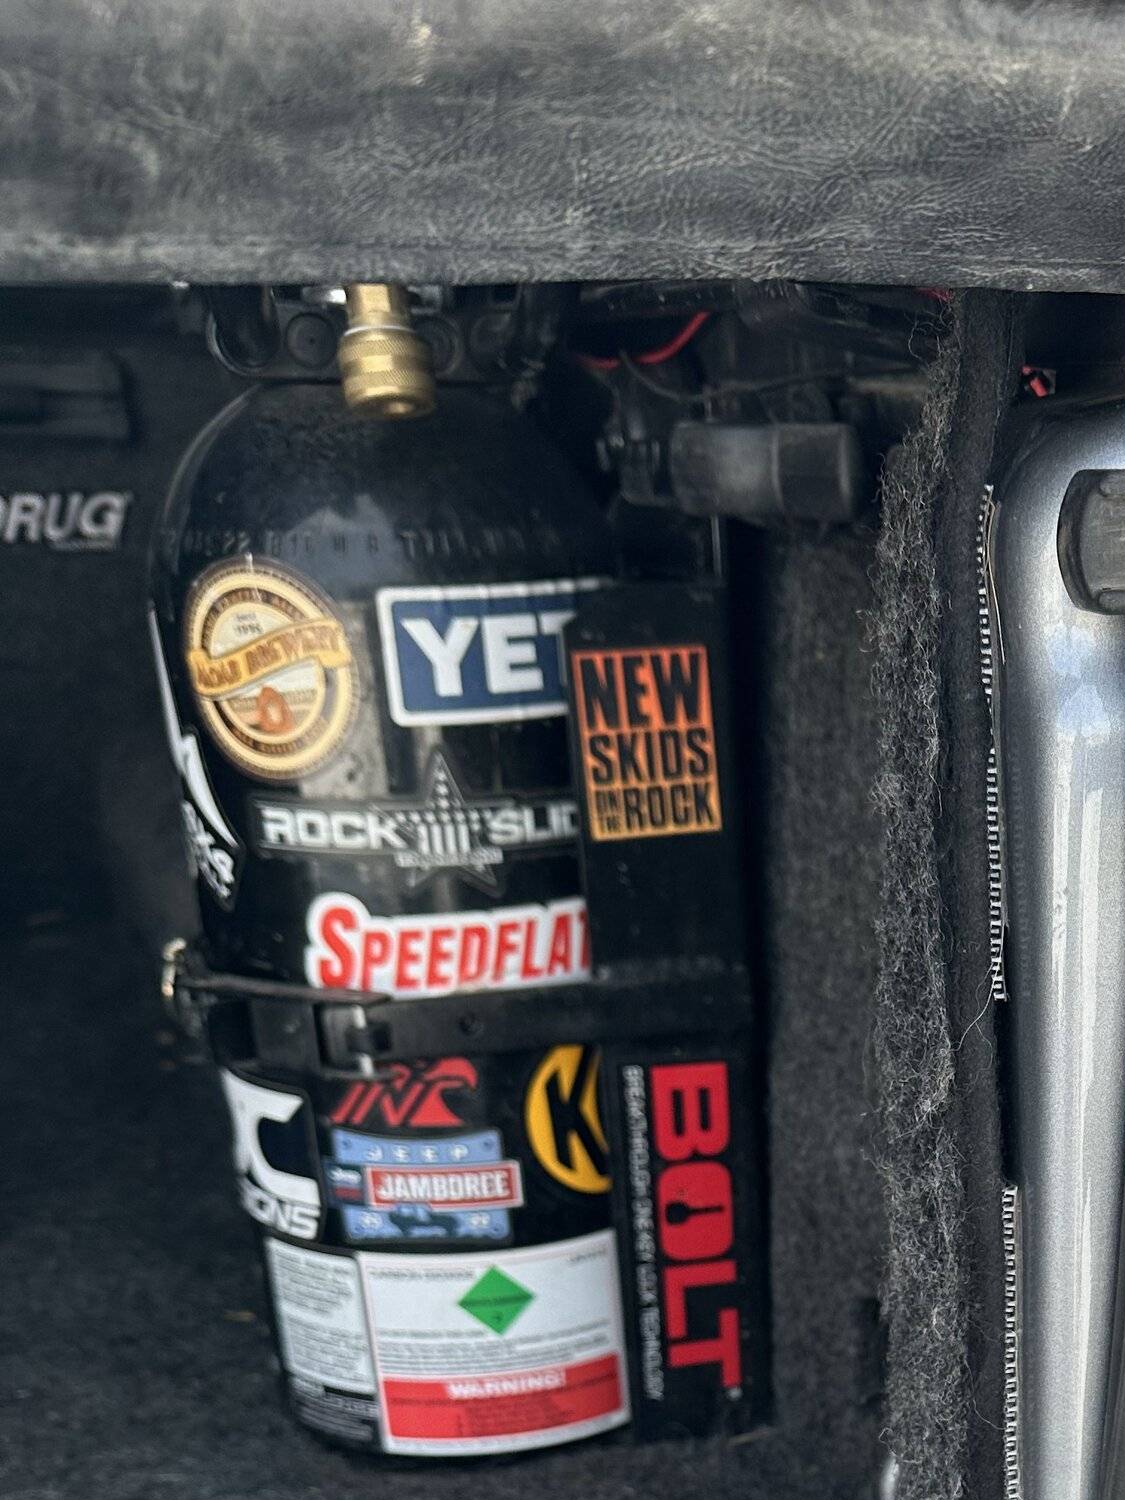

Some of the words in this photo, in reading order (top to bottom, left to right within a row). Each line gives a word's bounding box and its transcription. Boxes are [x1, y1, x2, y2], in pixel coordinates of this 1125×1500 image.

[0, 492, 127, 543] RUG
[579, 653, 702, 731] NEW
[589, 727, 709, 787] SKIDS
[260, 804, 406, 850] ROCK
[623, 782, 714, 831] ROCK
[366, 1144, 469, 1164] JEEP
[375, 1168, 512, 1200] JAMBOREE
[651, 1061, 742, 1388] BOLT
